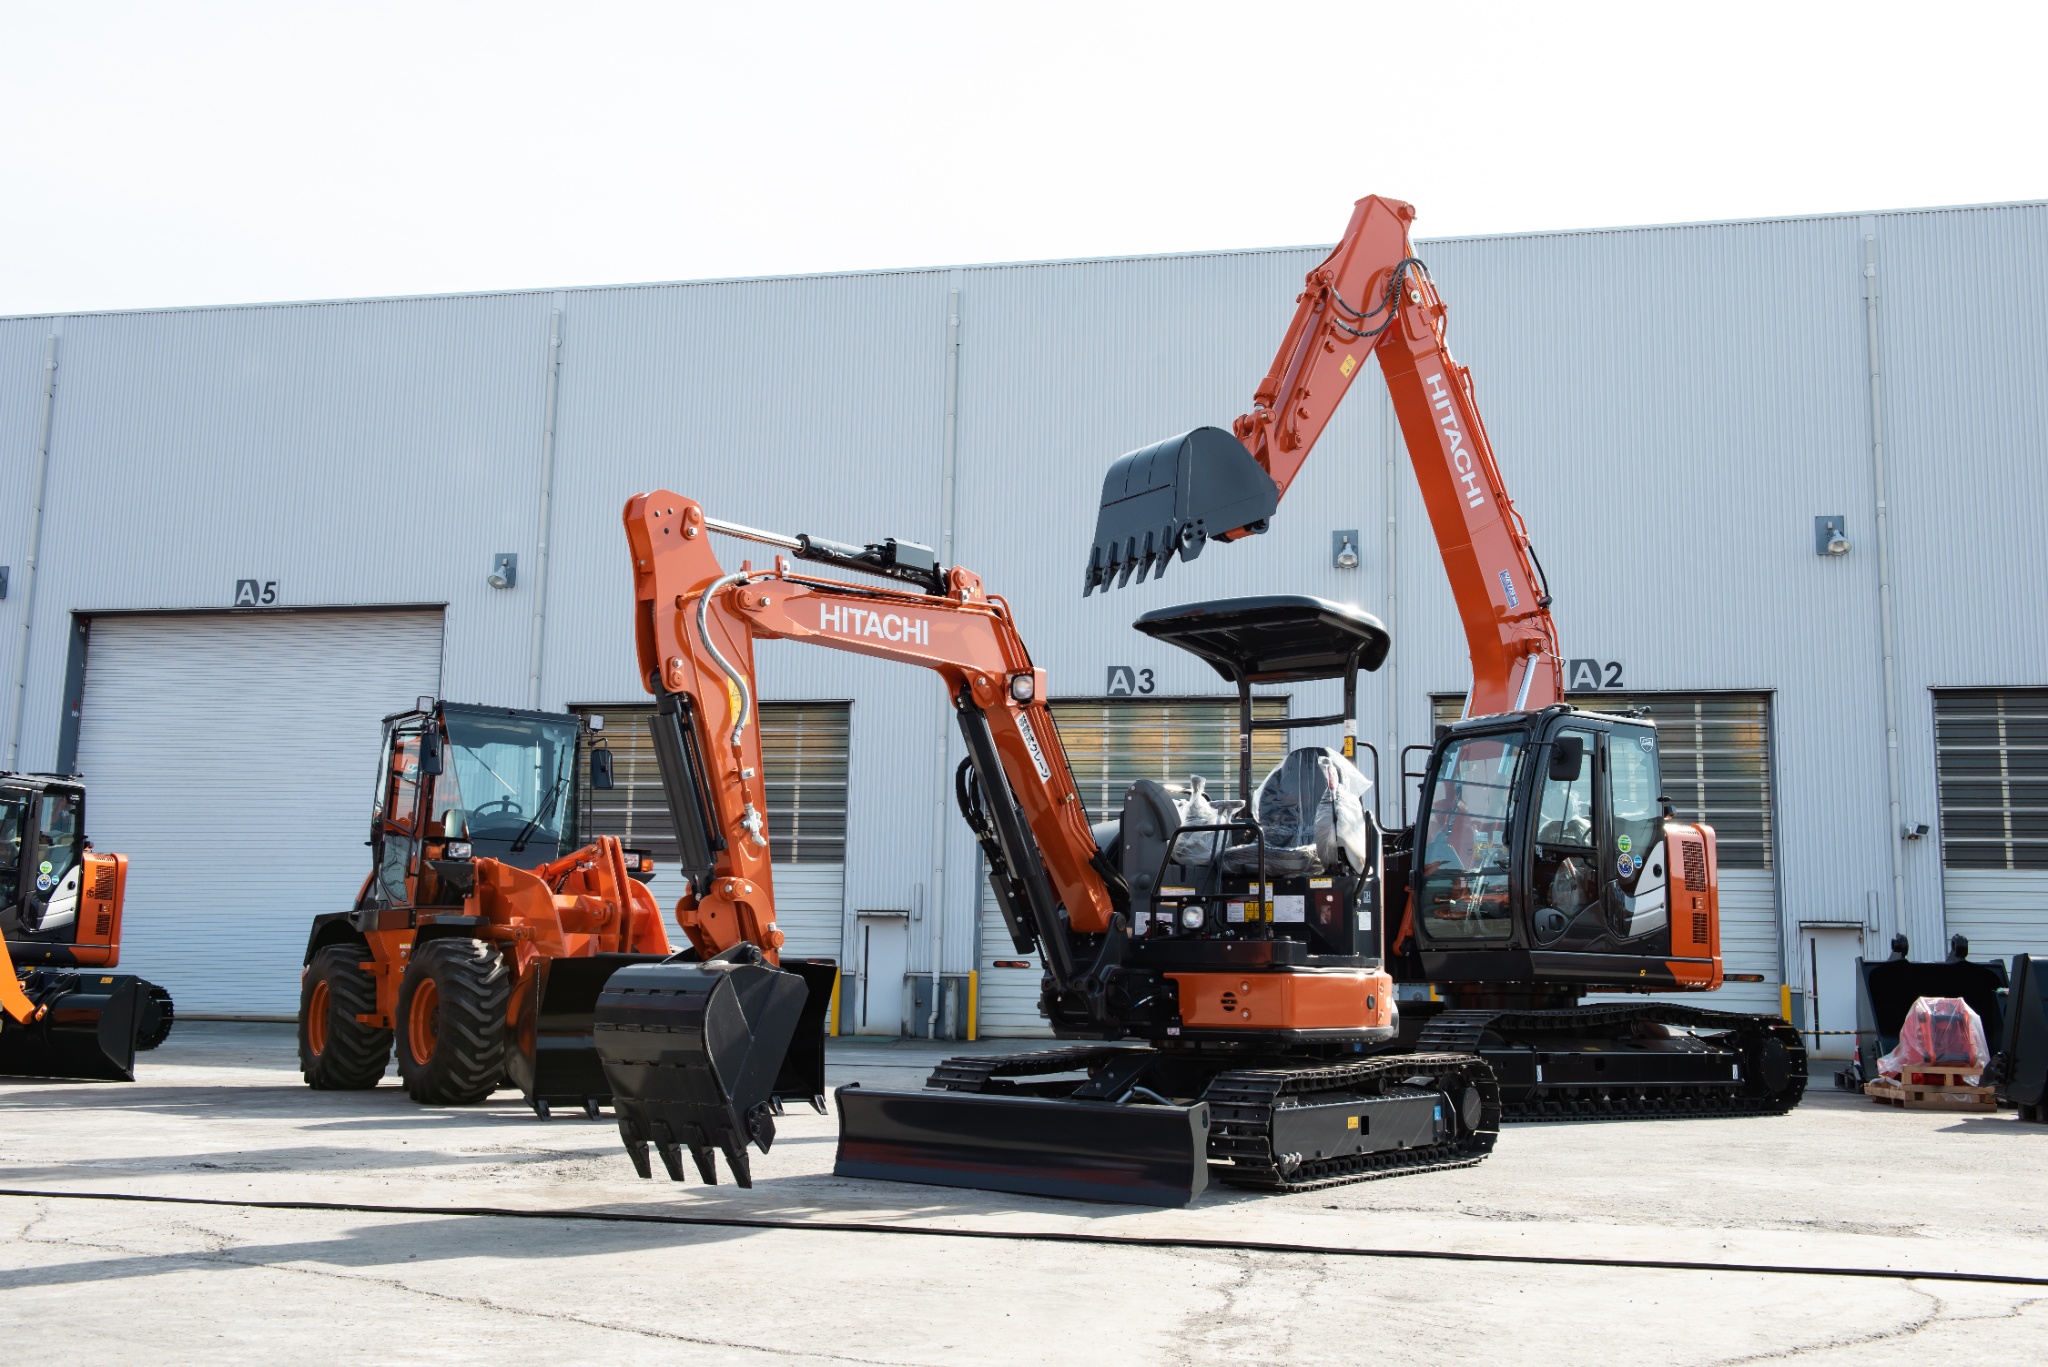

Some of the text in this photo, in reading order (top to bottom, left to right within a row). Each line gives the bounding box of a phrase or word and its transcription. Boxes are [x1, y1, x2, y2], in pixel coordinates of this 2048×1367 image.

[1426, 373, 1485, 509] HITACHI
[235, 580, 277, 605] A5
[820, 602, 929, 646] HITACHI
[1107, 668, 1155, 694] A3
[1571, 660, 1624, 689] A2
